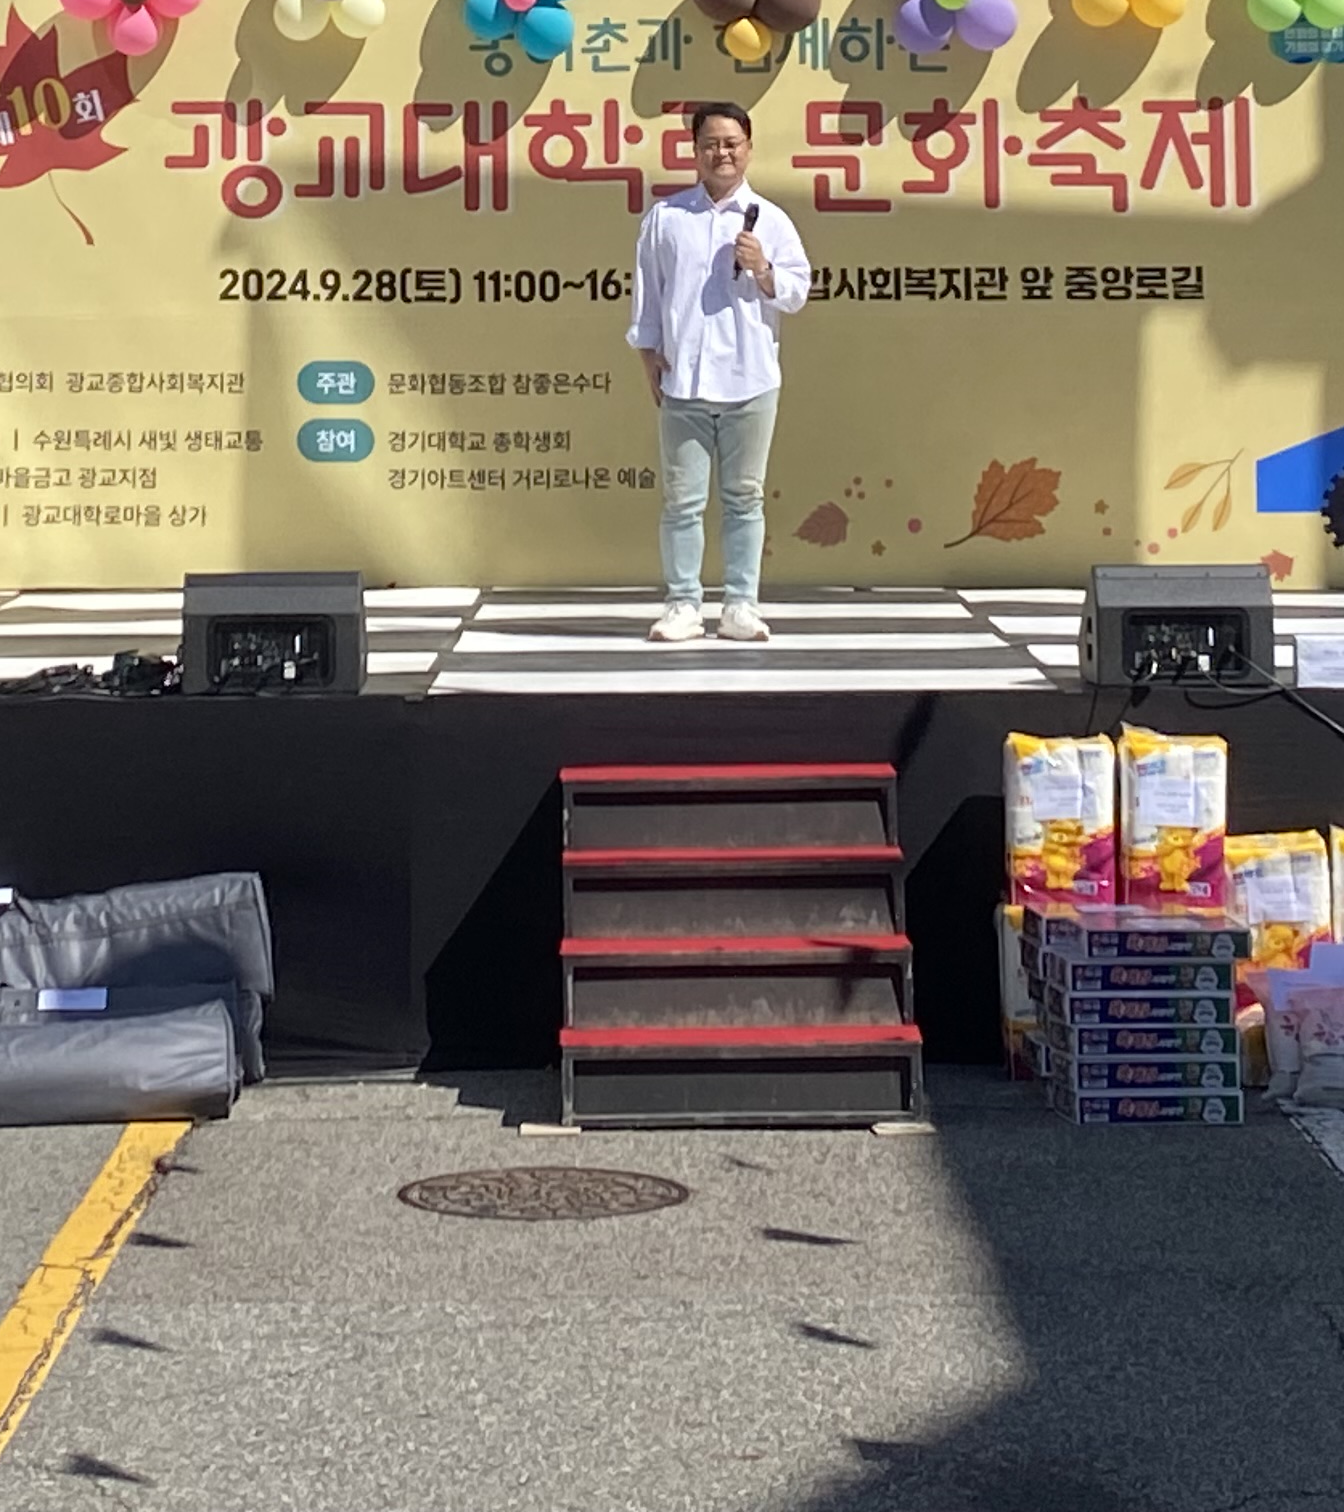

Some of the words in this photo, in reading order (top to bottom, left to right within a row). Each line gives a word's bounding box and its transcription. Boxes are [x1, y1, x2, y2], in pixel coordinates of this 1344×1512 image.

[468, 18, 693, 77] 농촌과
[791, 96, 1254, 213] 문화축제
[217, 267, 462, 305] 2024.9.28(토)
[472, 268, 633, 304] 11:00~16:
[808, 265, 1009, 302] 합사회복지관
[1019, 264, 1055, 301] 앞
[1063, 264, 1206, 301] 중앙로길
[65, 371, 246, 395] 광교종합사회복지관
[315, 371, 357, 395] 주관
[387, 372, 506, 396] 문화협동조합
[512, 371, 612, 396] 참좋은수다
[32, 429, 133, 452] 수원특례시
[138, 429, 179, 453] 새빛
[184, 430, 264, 453] 생태교통
[315, 429, 357, 453] 참여
[387, 430, 488, 453] 경기대학교
[492, 430, 572, 453] 총학생회
[77, 467, 158, 489] 광교지점
[387, 467, 506, 490] 경기아트센터
[512, 467, 611, 490] 거리로나온
[21, 504, 162, 527] 광교대학로마을
[168, 504, 207, 527] 상가
